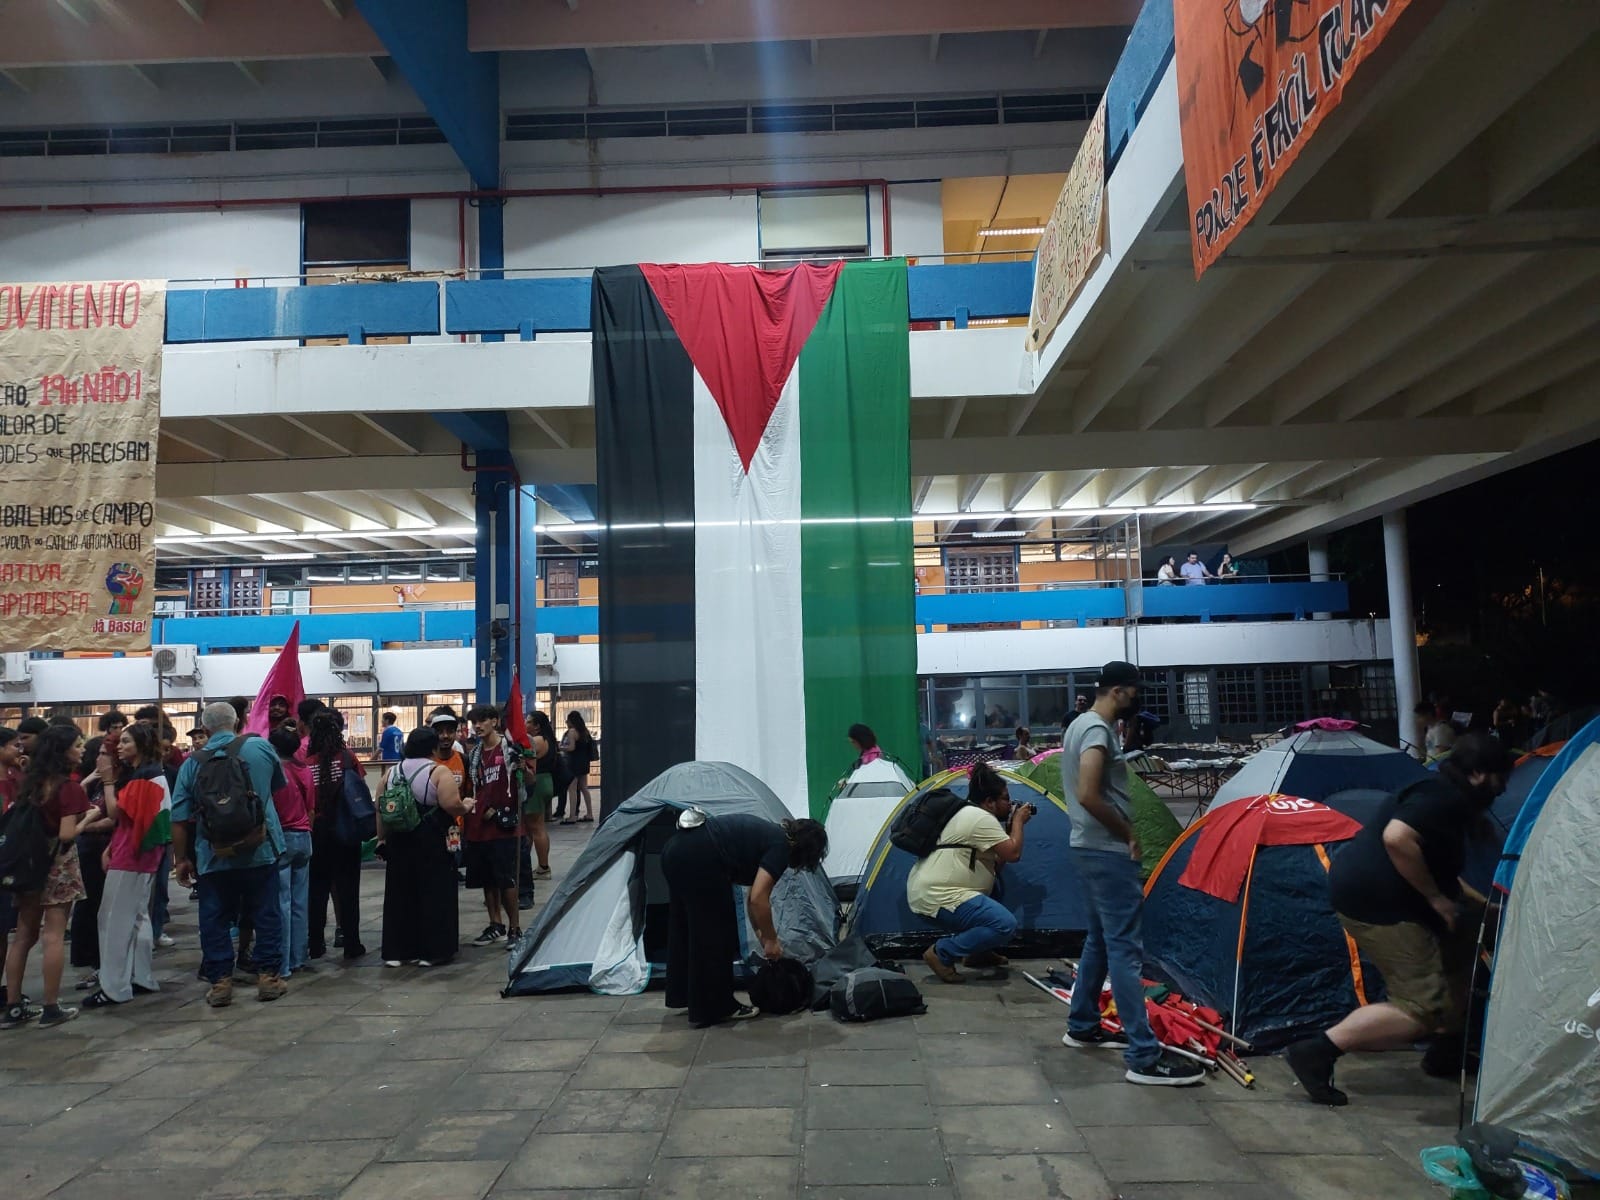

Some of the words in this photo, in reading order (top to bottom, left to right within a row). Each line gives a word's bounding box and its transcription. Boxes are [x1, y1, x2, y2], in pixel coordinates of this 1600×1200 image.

[1251, 113, 1264, 197] É
[1264, 52, 1319, 170] FÁCIL
[43, 413, 67, 435] DE
[46, 447, 64, 459] QUE
[70, 441, 150, 464] PRECISAM
[0, 504, 73, 527] BALHOS
[75, 509, 89, 521] DE
[92, 501, 154, 527] CAMPO
[0, 563, 61, 582] ATIVA
[92, 618, 105, 633] Já
[108, 619, 147, 633] Basta!
